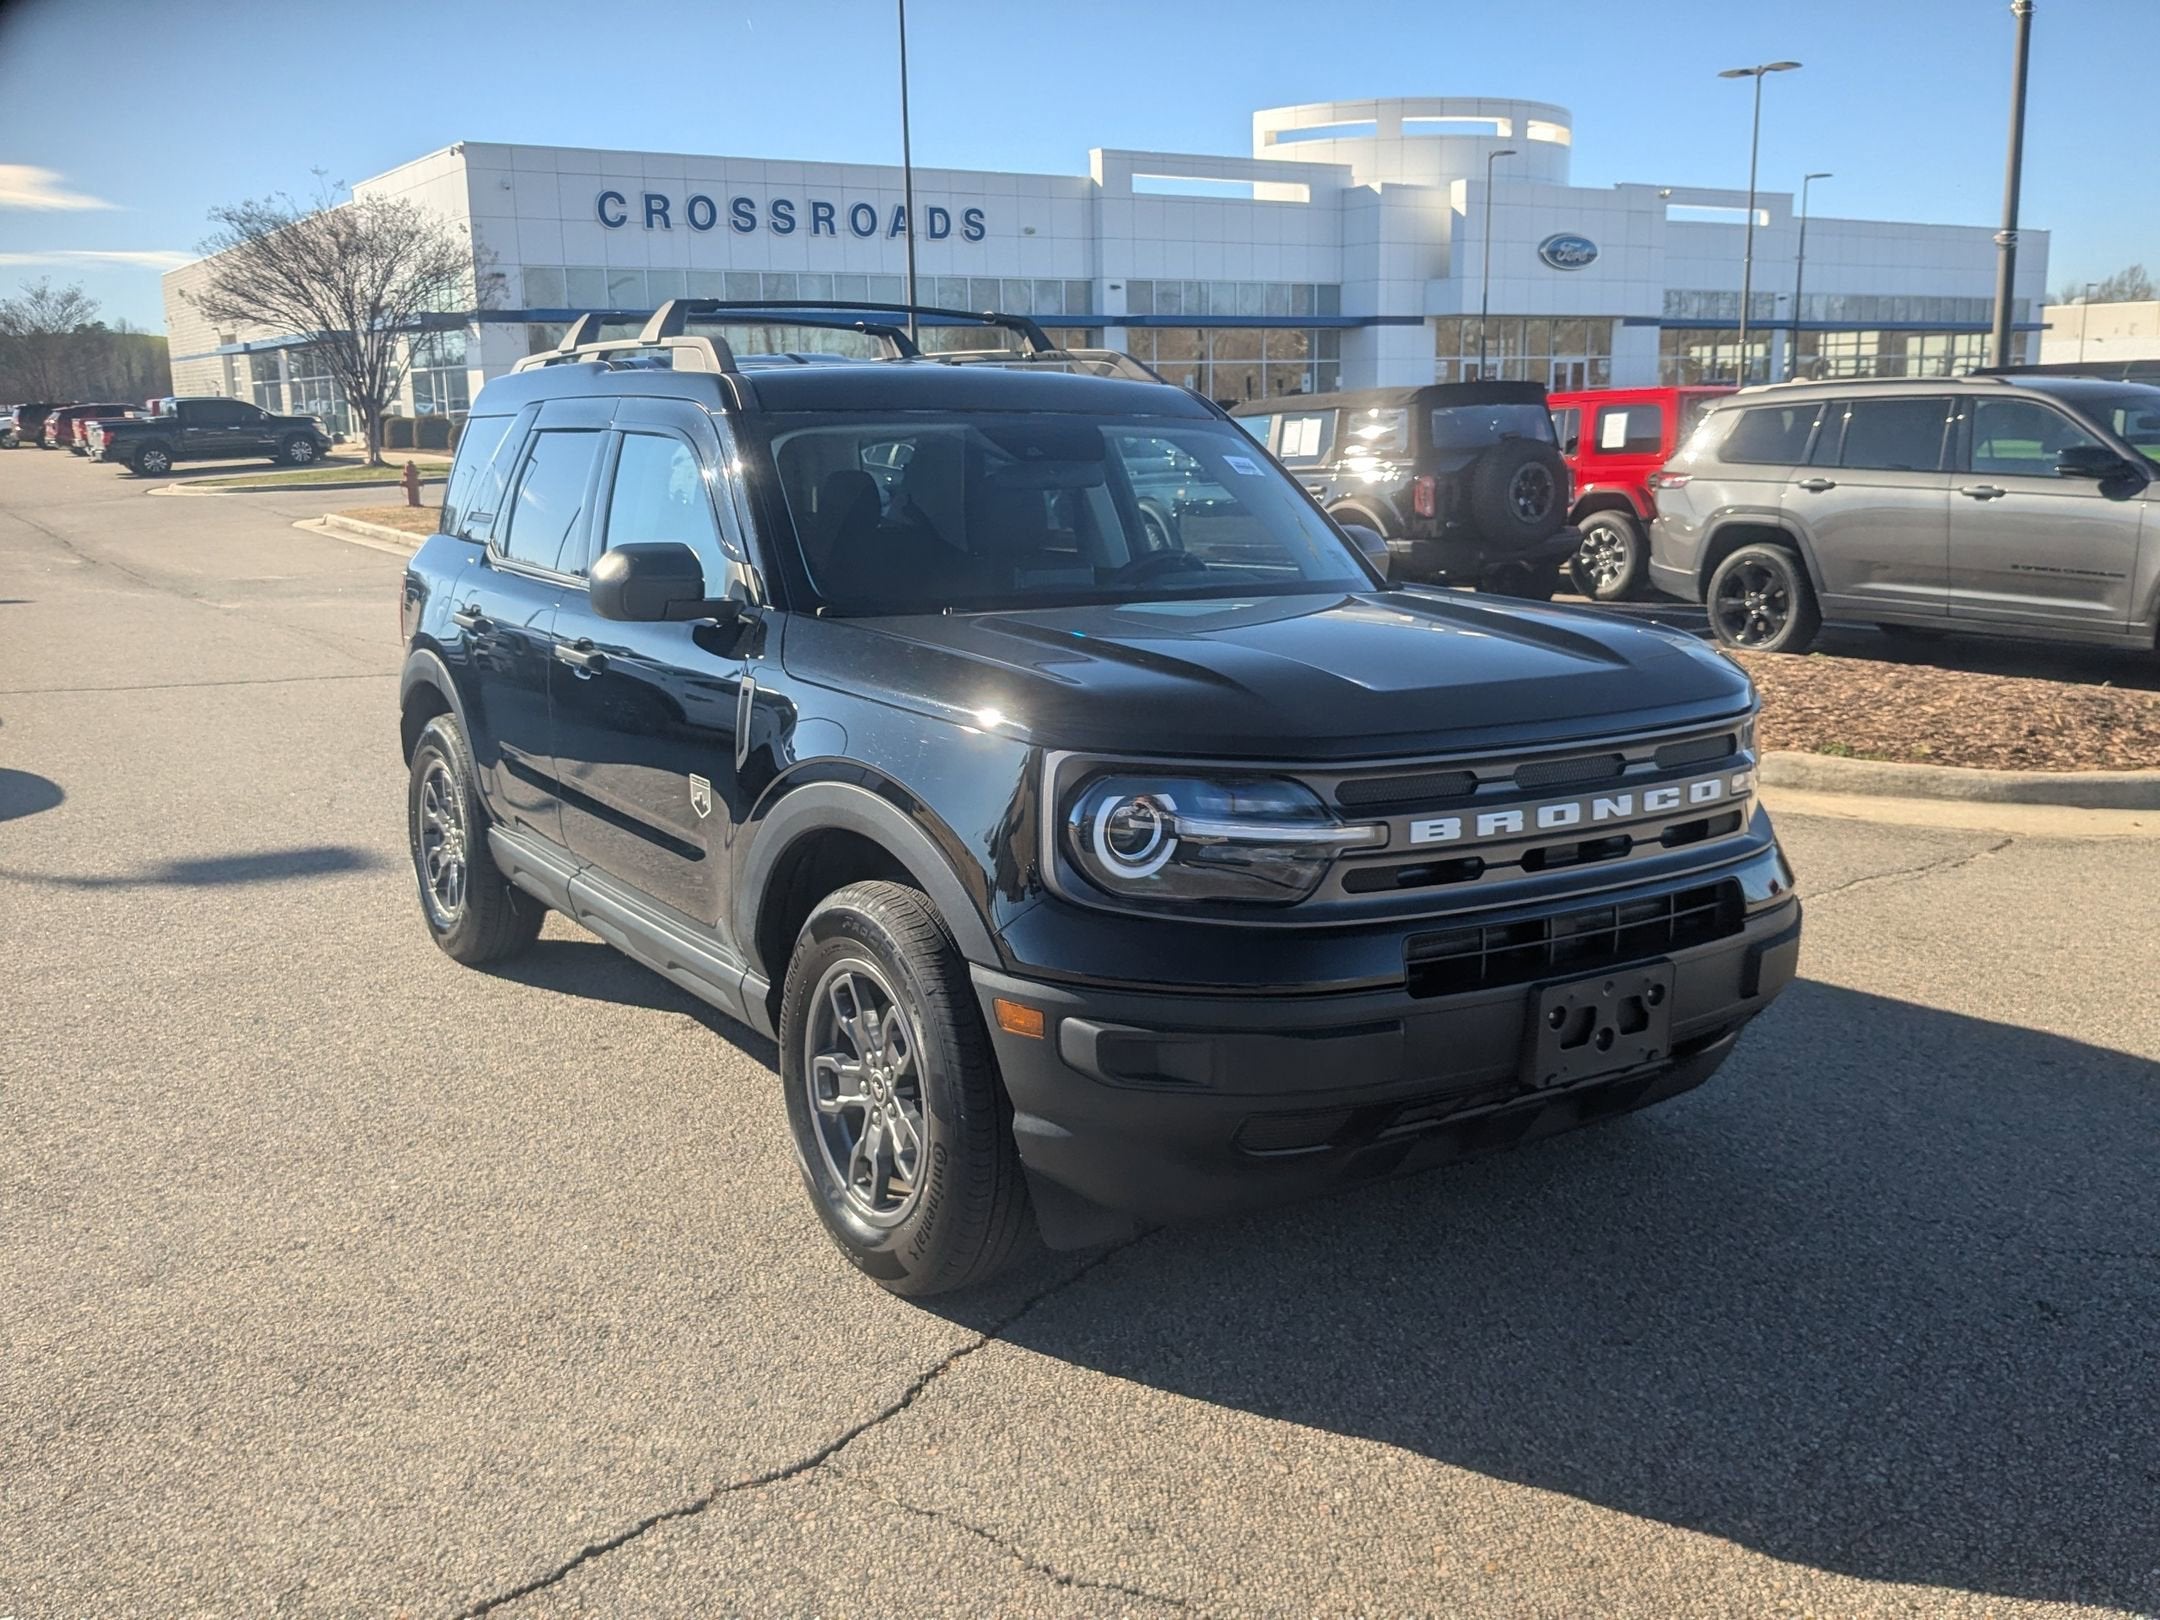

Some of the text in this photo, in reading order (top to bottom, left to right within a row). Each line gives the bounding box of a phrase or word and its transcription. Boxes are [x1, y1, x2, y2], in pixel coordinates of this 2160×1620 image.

[596, 188, 986, 243] CROSSROADS
[1409, 778, 1721, 844] BRONCO
[912, 1141, 949, 1255] Continental
